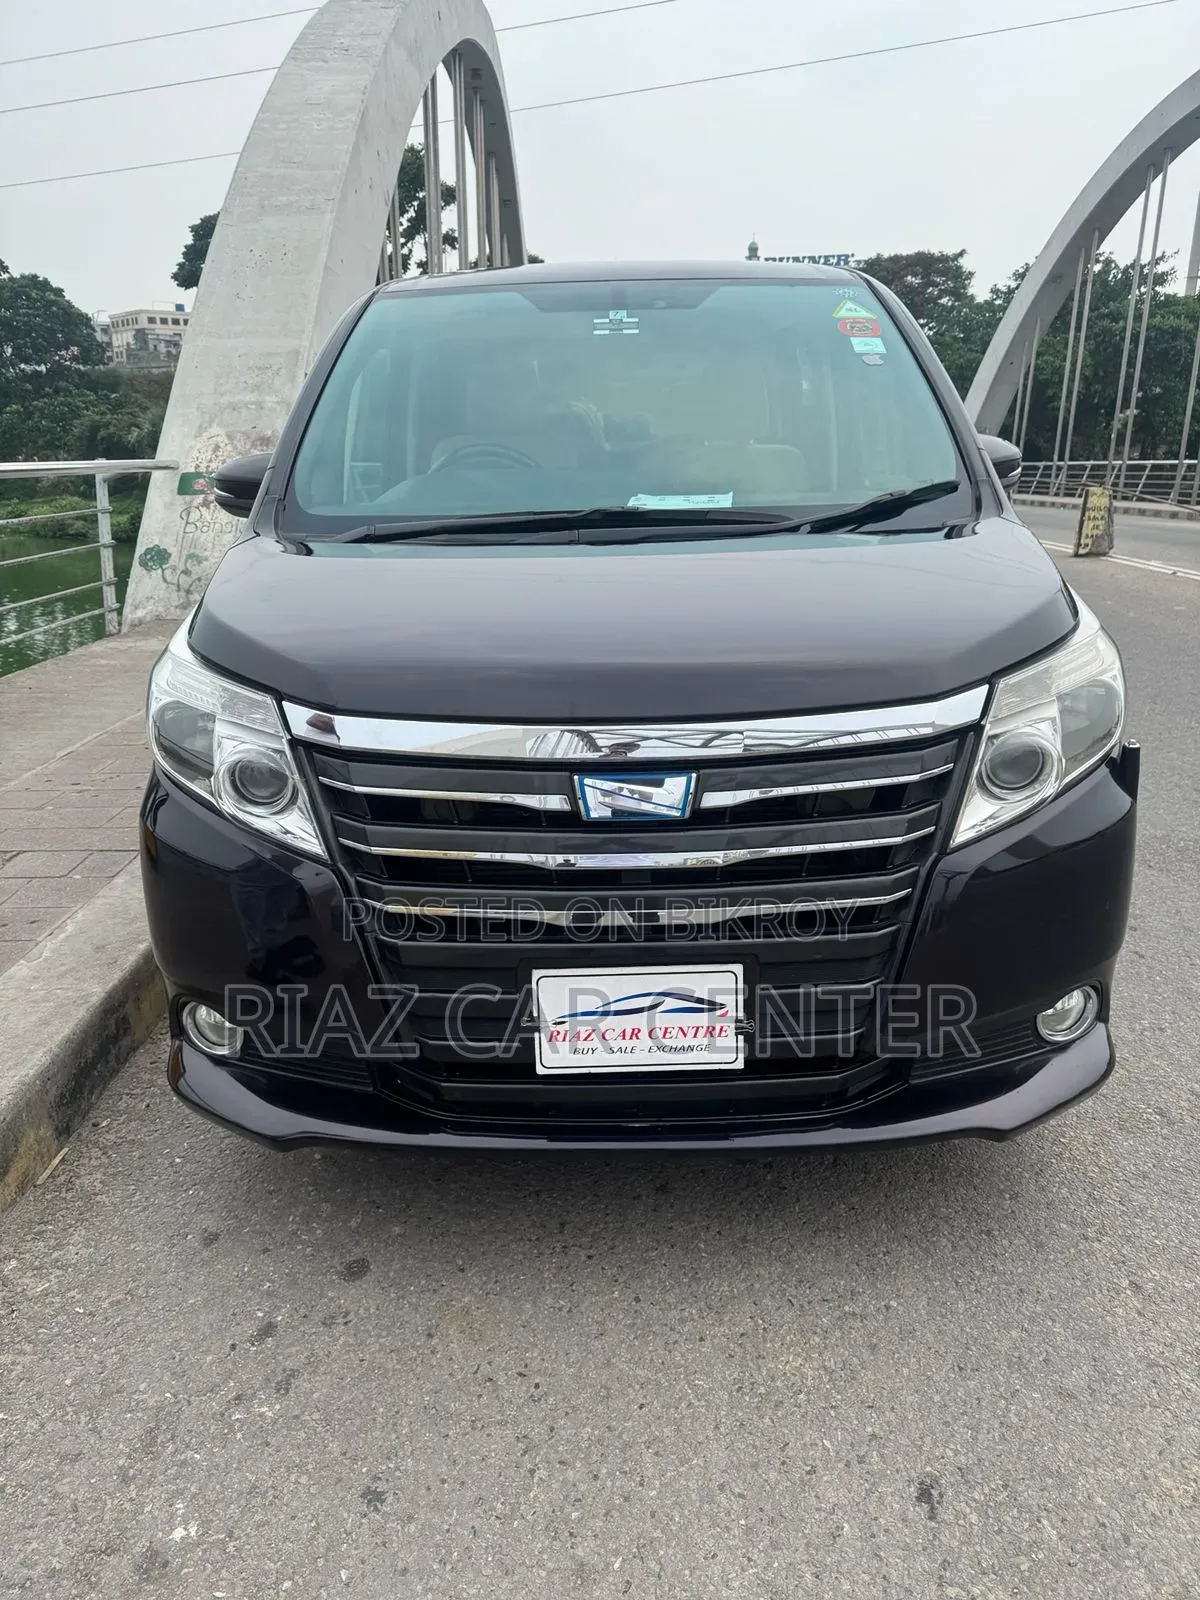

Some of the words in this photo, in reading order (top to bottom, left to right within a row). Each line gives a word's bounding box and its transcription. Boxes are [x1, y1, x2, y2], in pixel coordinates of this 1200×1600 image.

[547, 1028, 597, 1043] RIAZ
[601, 1027, 641, 1042] CAR
[648, 1025, 730, 1040] CENTRE
[573, 1047, 598, 1056] BUY
[608, 1046, 637, 1055] SALE
[648, 1043, 712, 1054] EXCHANGE
